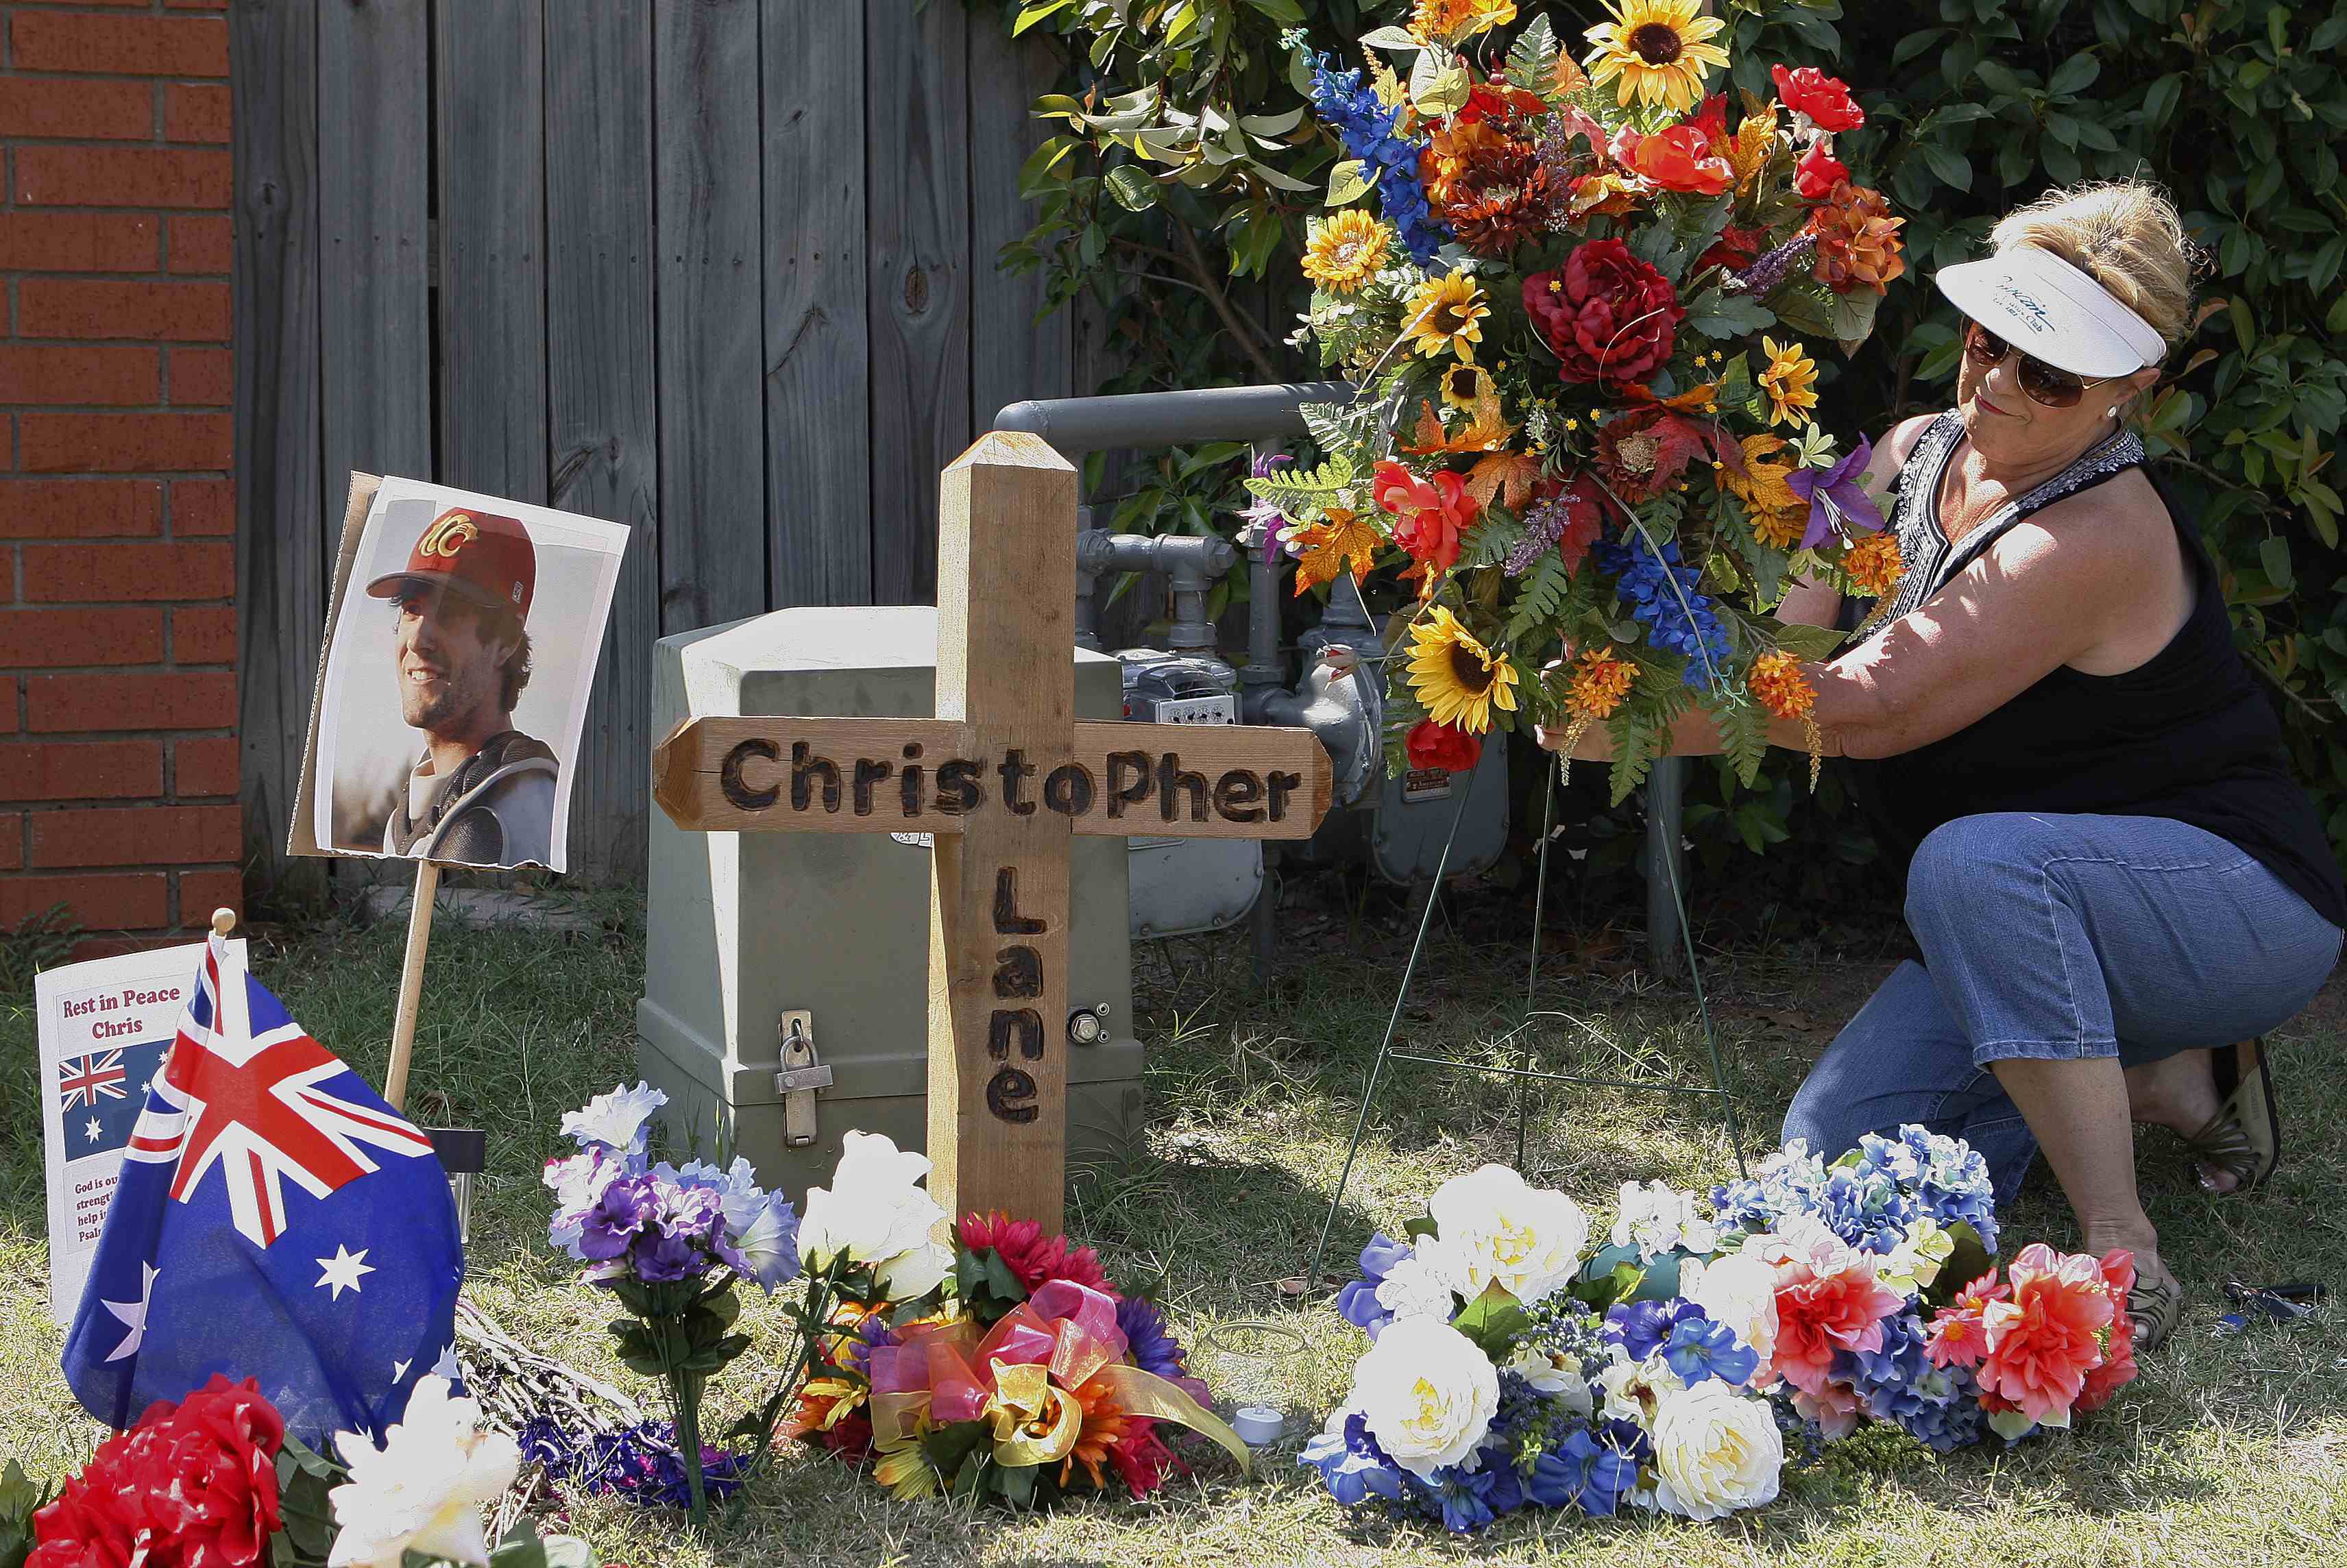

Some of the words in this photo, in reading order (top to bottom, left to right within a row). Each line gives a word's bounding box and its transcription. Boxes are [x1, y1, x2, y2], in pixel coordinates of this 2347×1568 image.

[63, 997, 96, 1018] Rest
[99, 994, 119, 1012] in
[122, 988, 180, 1007] Peace
[986, 866, 1049, 1124] Lane
[92, 1017, 143, 1039] Chris
[75, 1180, 93, 1194] God
[95, 1179, 103, 1188] is
[105, 1176, 118, 1186] ou
[76, 1192, 113, 1210] strengt
[77, 1213, 98, 1227] help
